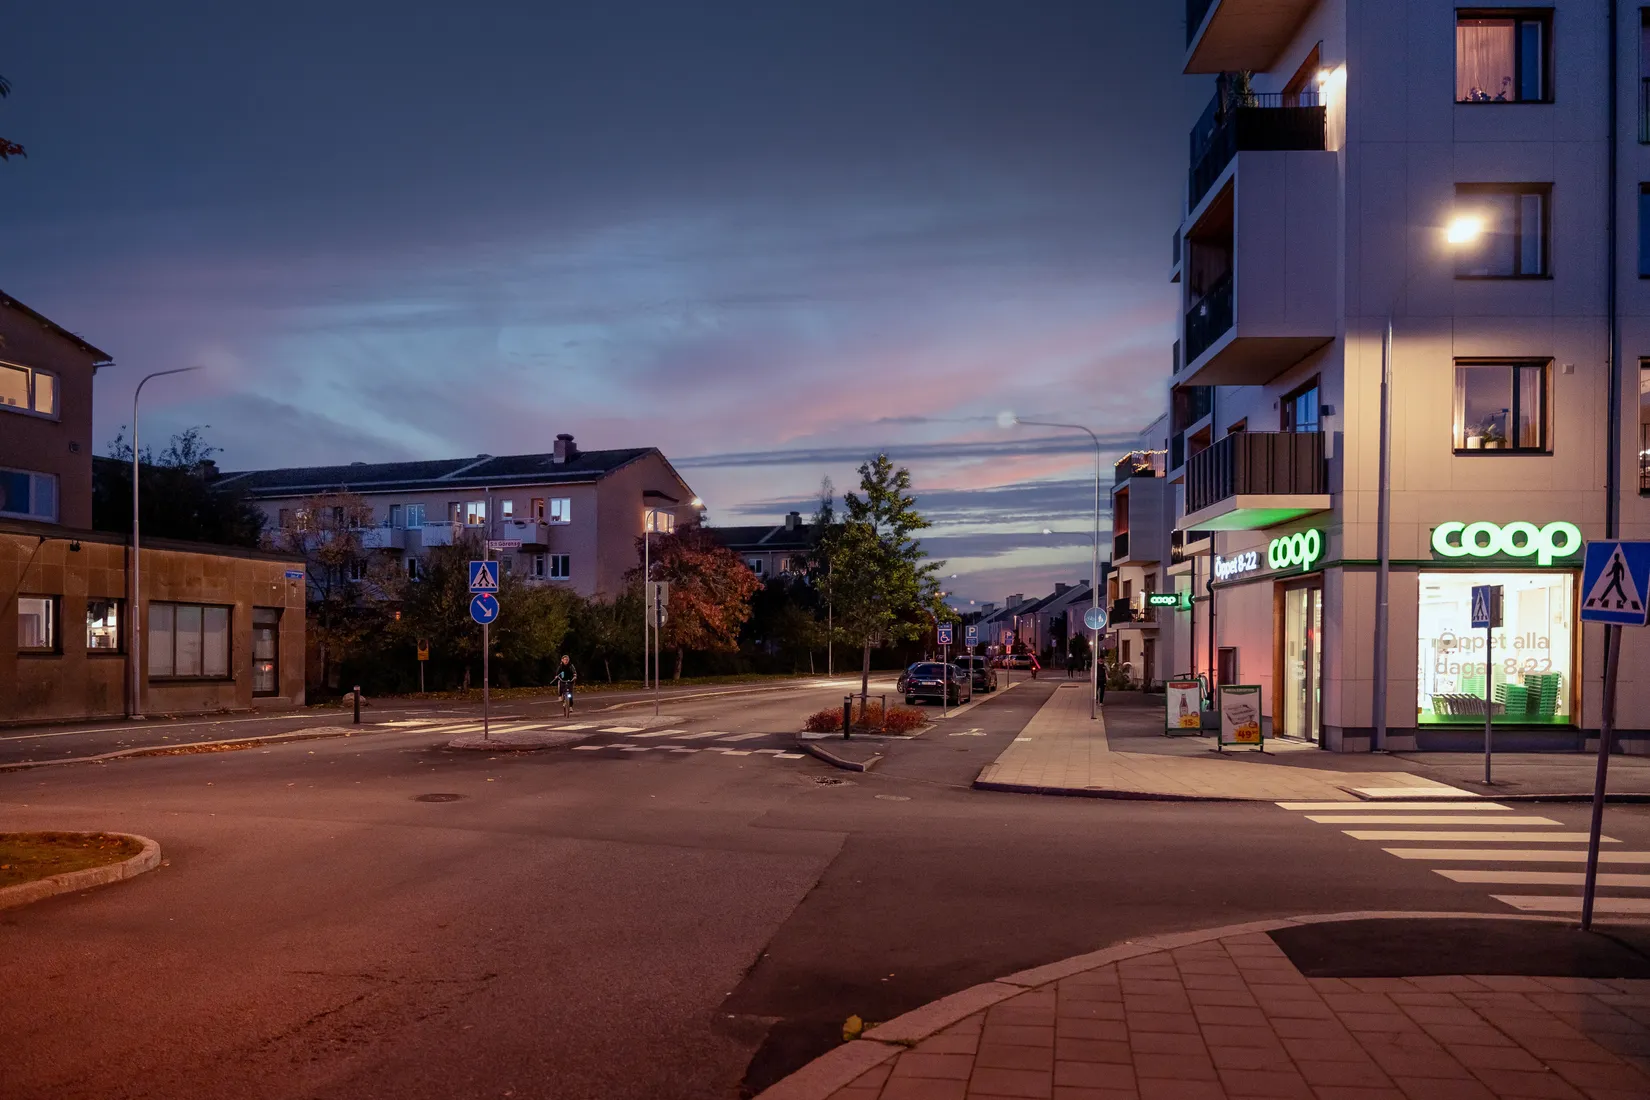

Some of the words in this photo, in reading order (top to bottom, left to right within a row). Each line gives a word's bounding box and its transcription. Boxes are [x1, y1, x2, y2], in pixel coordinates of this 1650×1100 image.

[1267, 528, 1321, 571] coop
[1431, 521, 1582, 566] coop
[1215, 555, 1237, 580] Öppet
[1239, 551, 1257, 573] 8-22
[1150, 596, 1177, 605] coop
[968, 627, 976, 636] P
[1439, 628, 1507, 653] Öppet
[1513, 632, 1550, 650] alla
